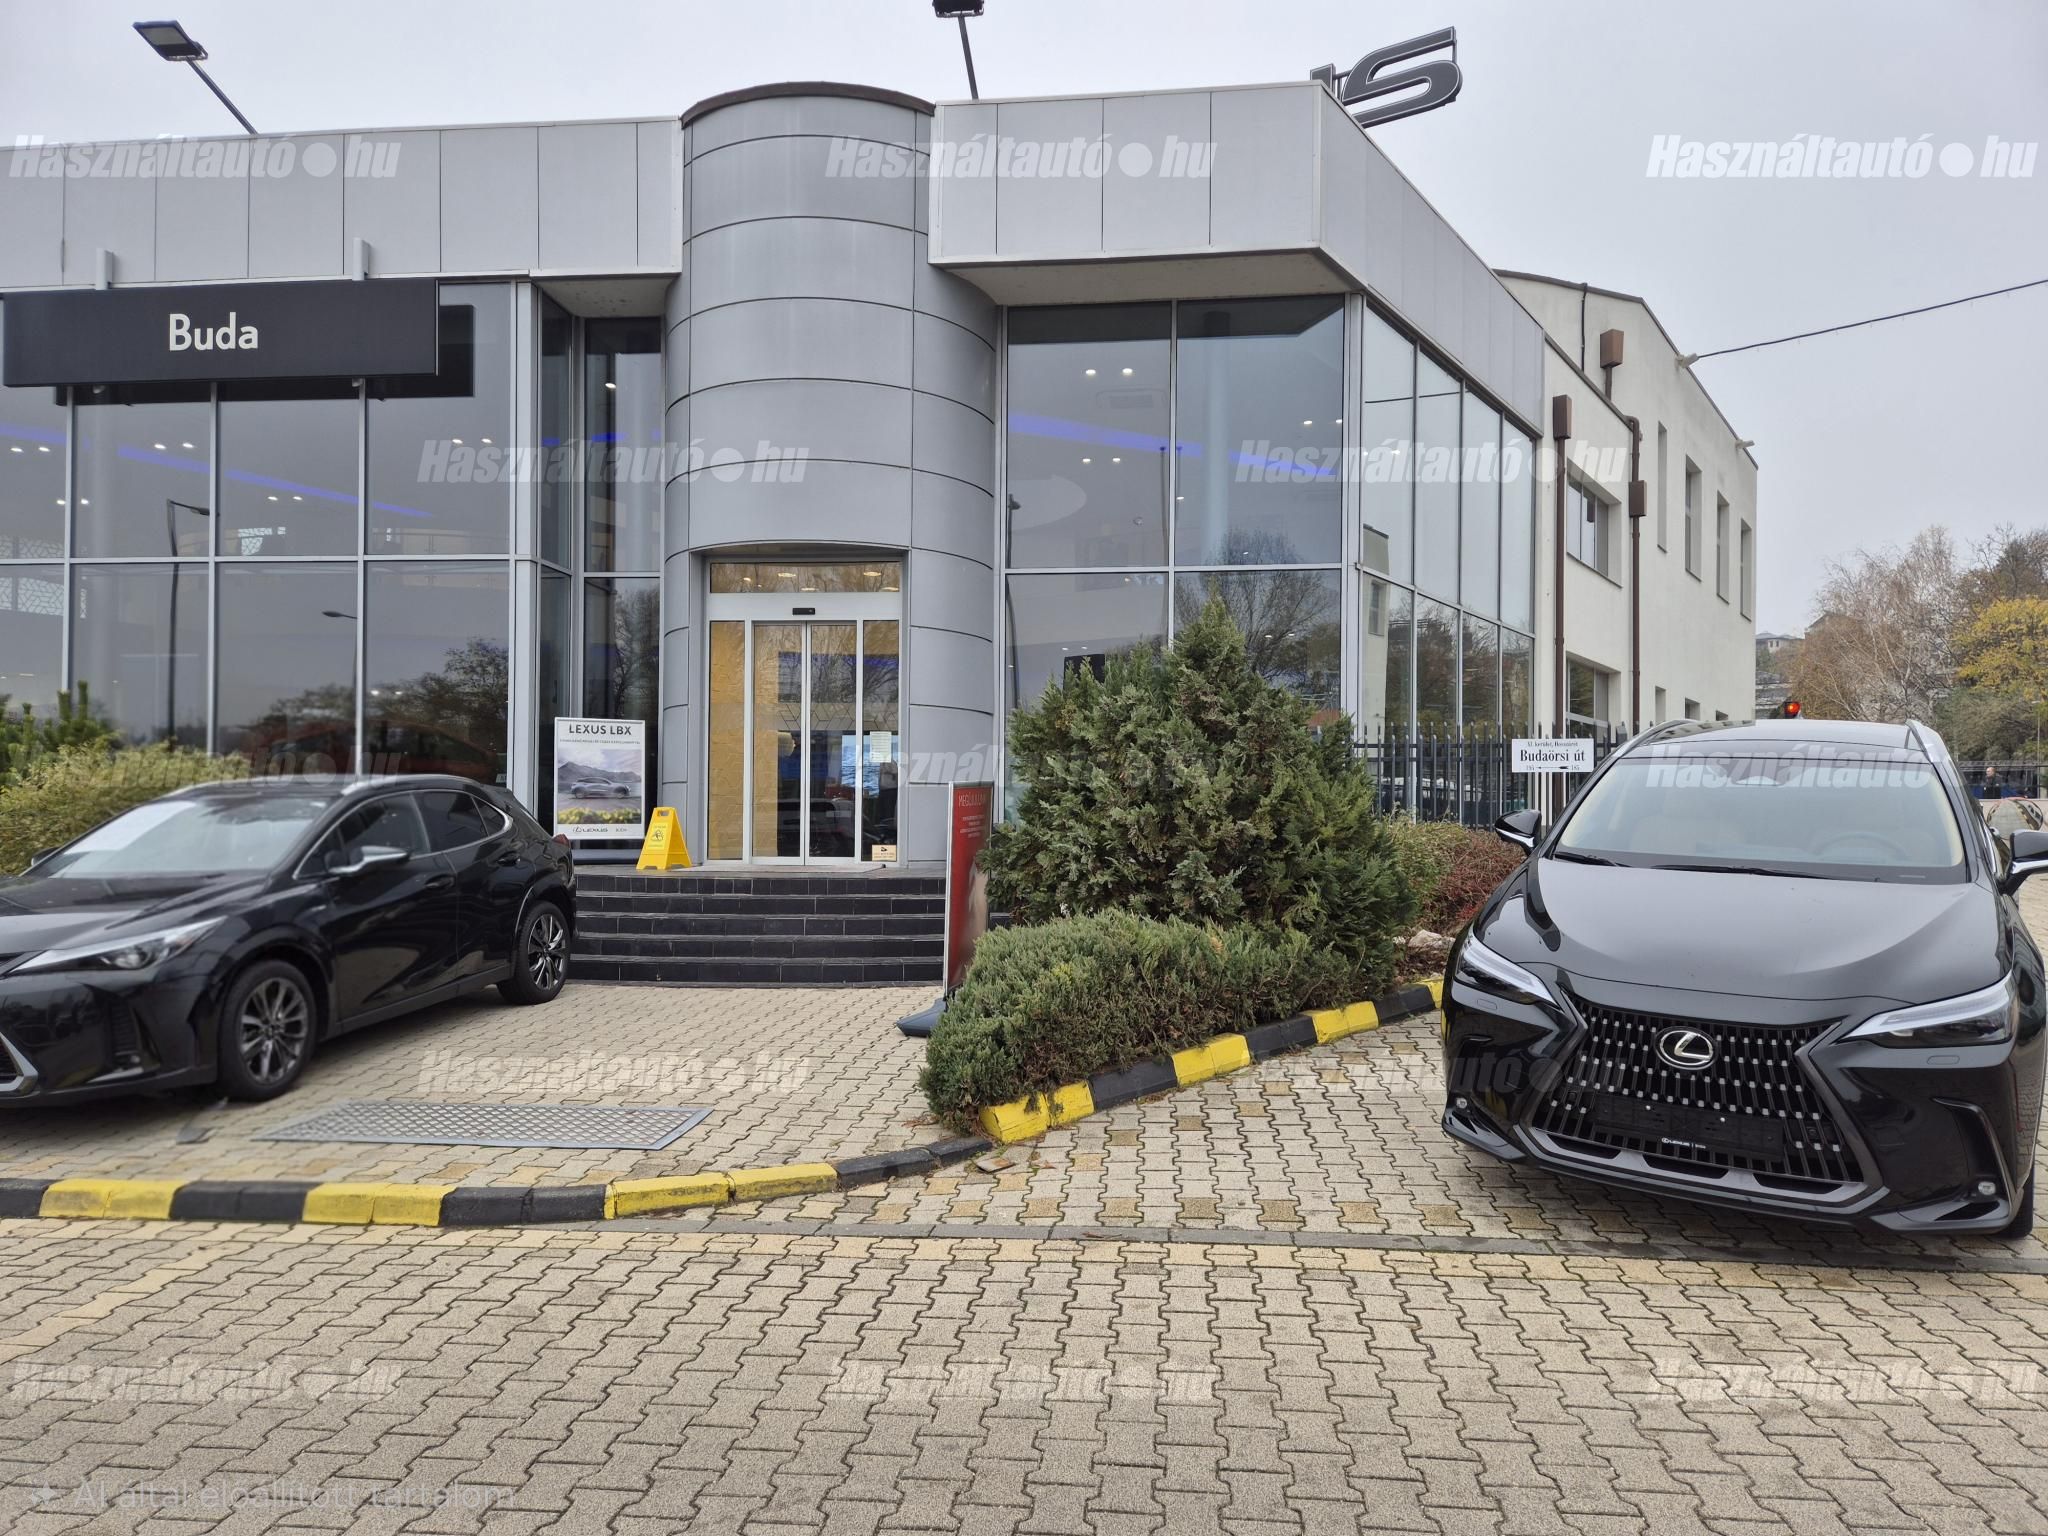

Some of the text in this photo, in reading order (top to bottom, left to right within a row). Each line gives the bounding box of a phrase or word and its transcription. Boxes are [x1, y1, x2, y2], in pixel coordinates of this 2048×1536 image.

[169, 311, 259, 351] Buda
[569, 723, 632, 736] LEXUS LBX
[1520, 749, 1585, 762] Budaörsi út
